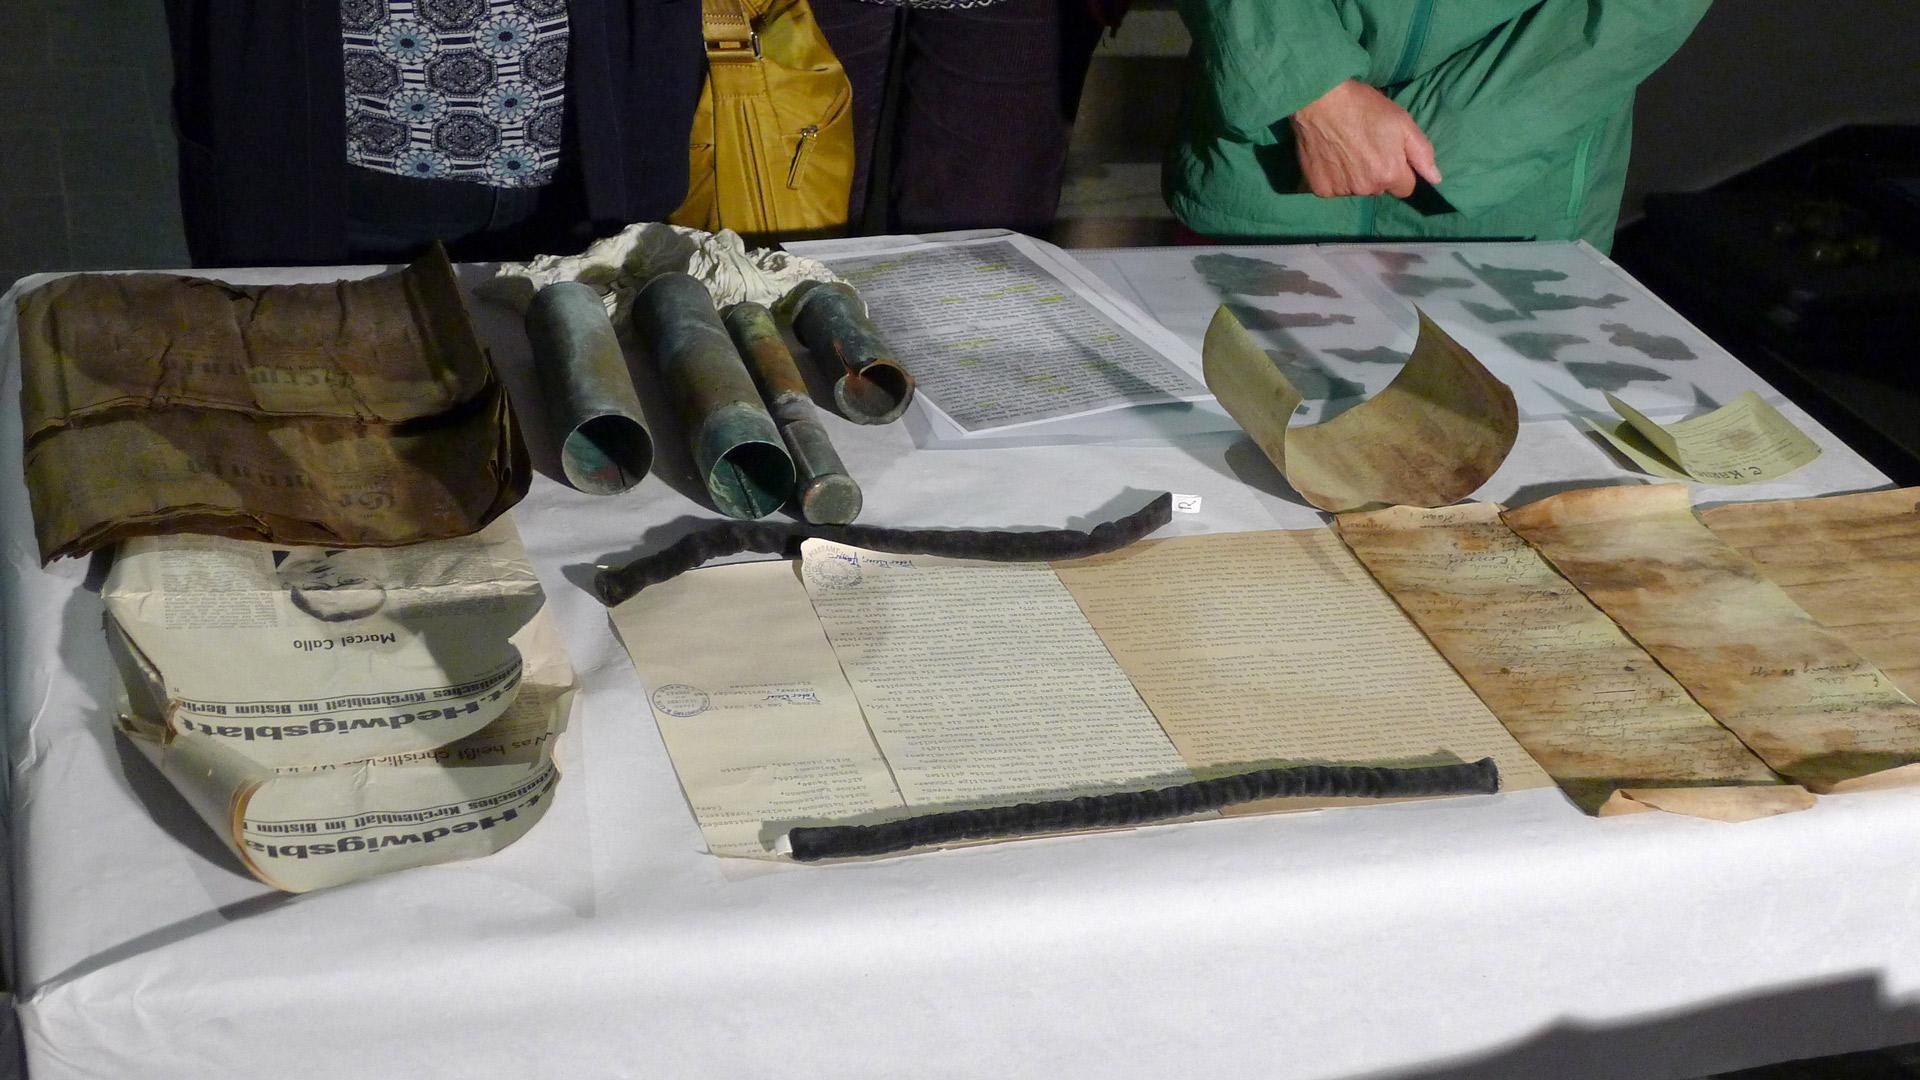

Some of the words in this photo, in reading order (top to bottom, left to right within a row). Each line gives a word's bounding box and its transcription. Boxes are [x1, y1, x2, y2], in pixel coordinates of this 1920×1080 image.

[293, 639, 335, 652] Callo
[341, 632, 397, 647] Marcel
[298, 702, 320, 714] im
[325, 691, 427, 712] Kirchenblatt
[234, 703, 292, 715] Bistum
[180, 701, 480, 742] Hedwigsblatt
[511, 731, 554, 750] Was
[353, 805, 462, 829] Kirchenblatt
[256, 821, 318, 834] Bistum
[325, 820, 347, 831] im
